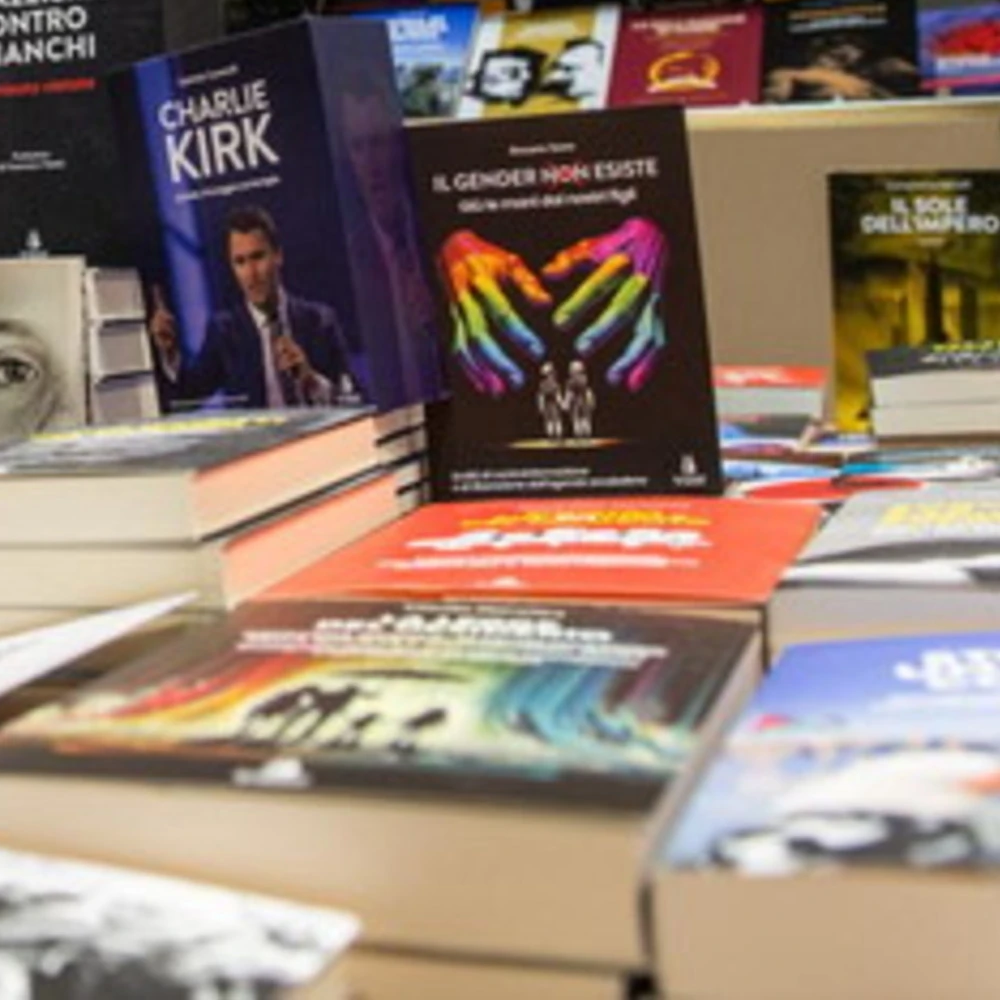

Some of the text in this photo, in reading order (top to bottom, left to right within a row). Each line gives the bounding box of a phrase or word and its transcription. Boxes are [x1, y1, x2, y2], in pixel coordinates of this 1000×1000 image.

[158, 78, 270, 130] CHARLIE
[165, 112, 280, 183] KIRK
[432, 157, 658, 193] IL GENDER NON ESISTE
[914, 195, 969, 213] SOLE
